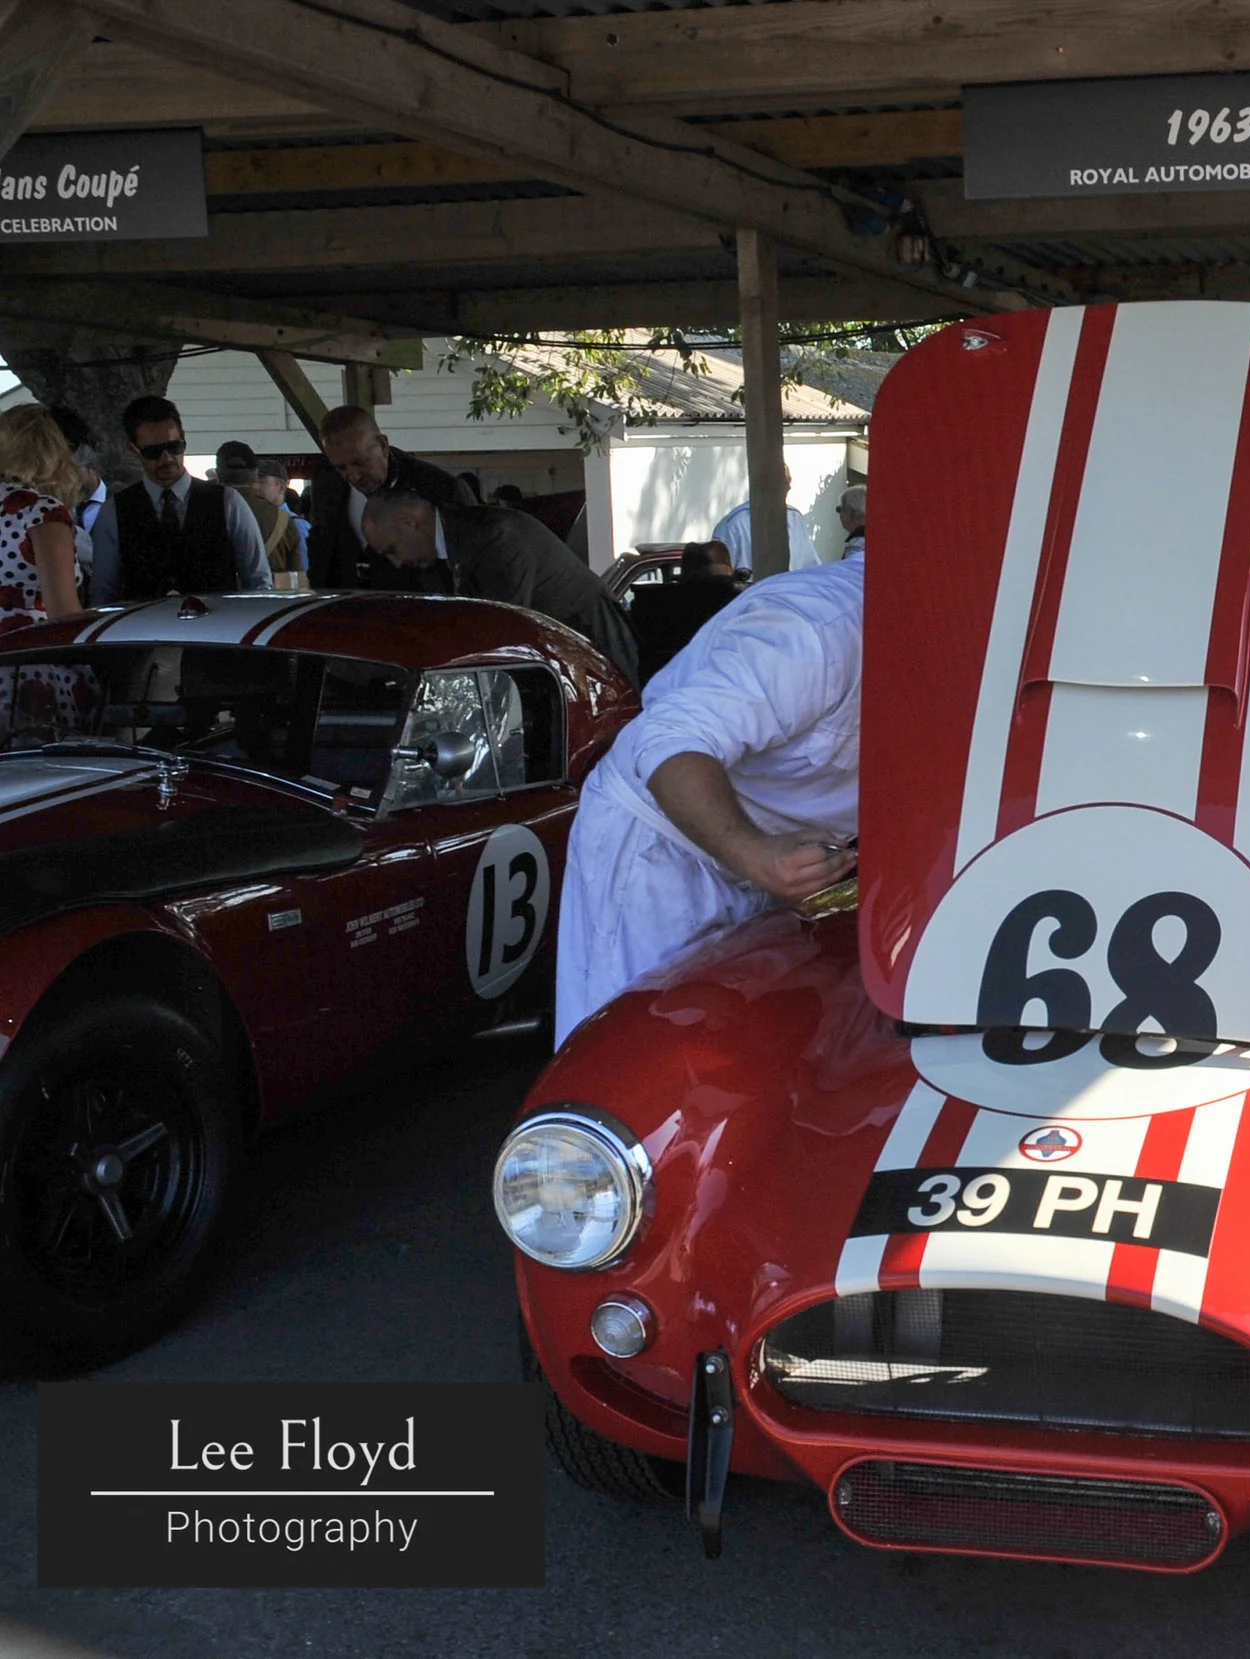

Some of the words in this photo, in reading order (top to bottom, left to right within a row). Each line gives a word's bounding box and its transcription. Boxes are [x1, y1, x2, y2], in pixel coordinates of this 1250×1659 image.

[0, 168, 48, 200] ans
[57, 163, 140, 208] Coupé
[1069, 167, 1139, 186] ROYAL
[0, 216, 118, 234] CELEBRATION
[477, 852, 538, 978] 13
[976, 889, 1222, 1070] 68
[907, 1173, 1011, 1227] 39
[1032, 1175, 1163, 1239] PH
